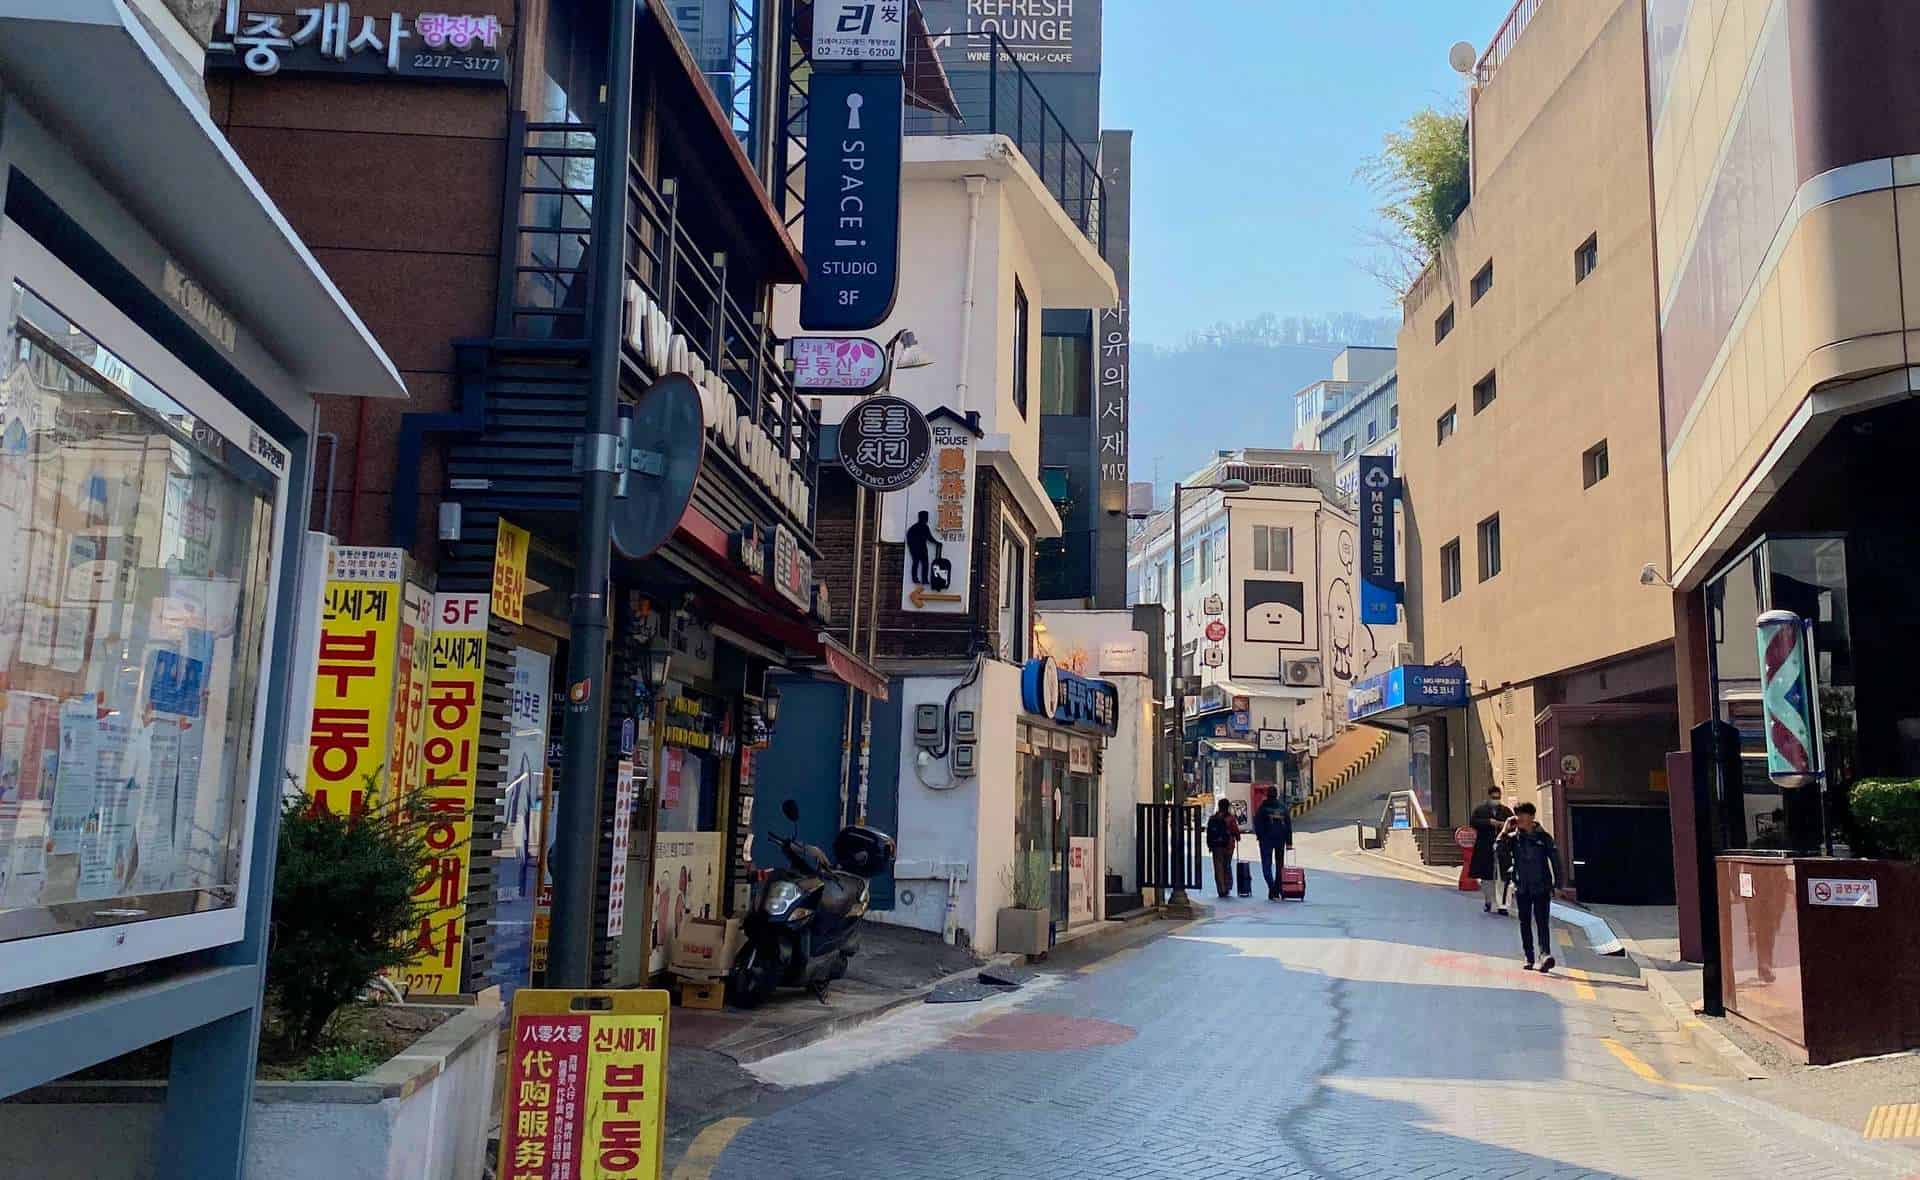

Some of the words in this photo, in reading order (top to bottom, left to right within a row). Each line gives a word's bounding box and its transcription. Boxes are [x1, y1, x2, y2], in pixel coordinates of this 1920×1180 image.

[880, 0, 899, 24] 发
[967, 0, 1073, 17] REFRESH
[418, 15, 499, 49] 행정사
[967, 18, 1073, 41] LOUNGE
[413, 53, 500, 72] 2277-3177
[967, 51, 991, 62] WINE
[1047, 53, 1072, 63] CAFE
[839, 140, 865, 229] SPACE
[821, 261, 878, 275] STUDIO
[838, 290, 860, 305] 3F
[796, 357, 852, 377] 부동산
[861, 407, 907, 433] 둘둘
[859, 440, 906, 465] 치킨
[934, 436, 968, 446] HOUSE
[845, 457, 863, 476] TWO
[887, 456, 924, 484] CHICKEN
[323, 588, 388, 622] 신세계
[492, 565, 523, 620] 부동산
[442, 599, 479, 625] 5F
[433, 638, 482, 670] 신세계
[1422, 685, 1438, 695] 365
[410, 680, 476, 970] 공인중개사
[523, 1024, 583, 1043] 八零久零
[593, 1026, 657, 1053] 신세계
[600, 1063, 645, 1180] 부동
